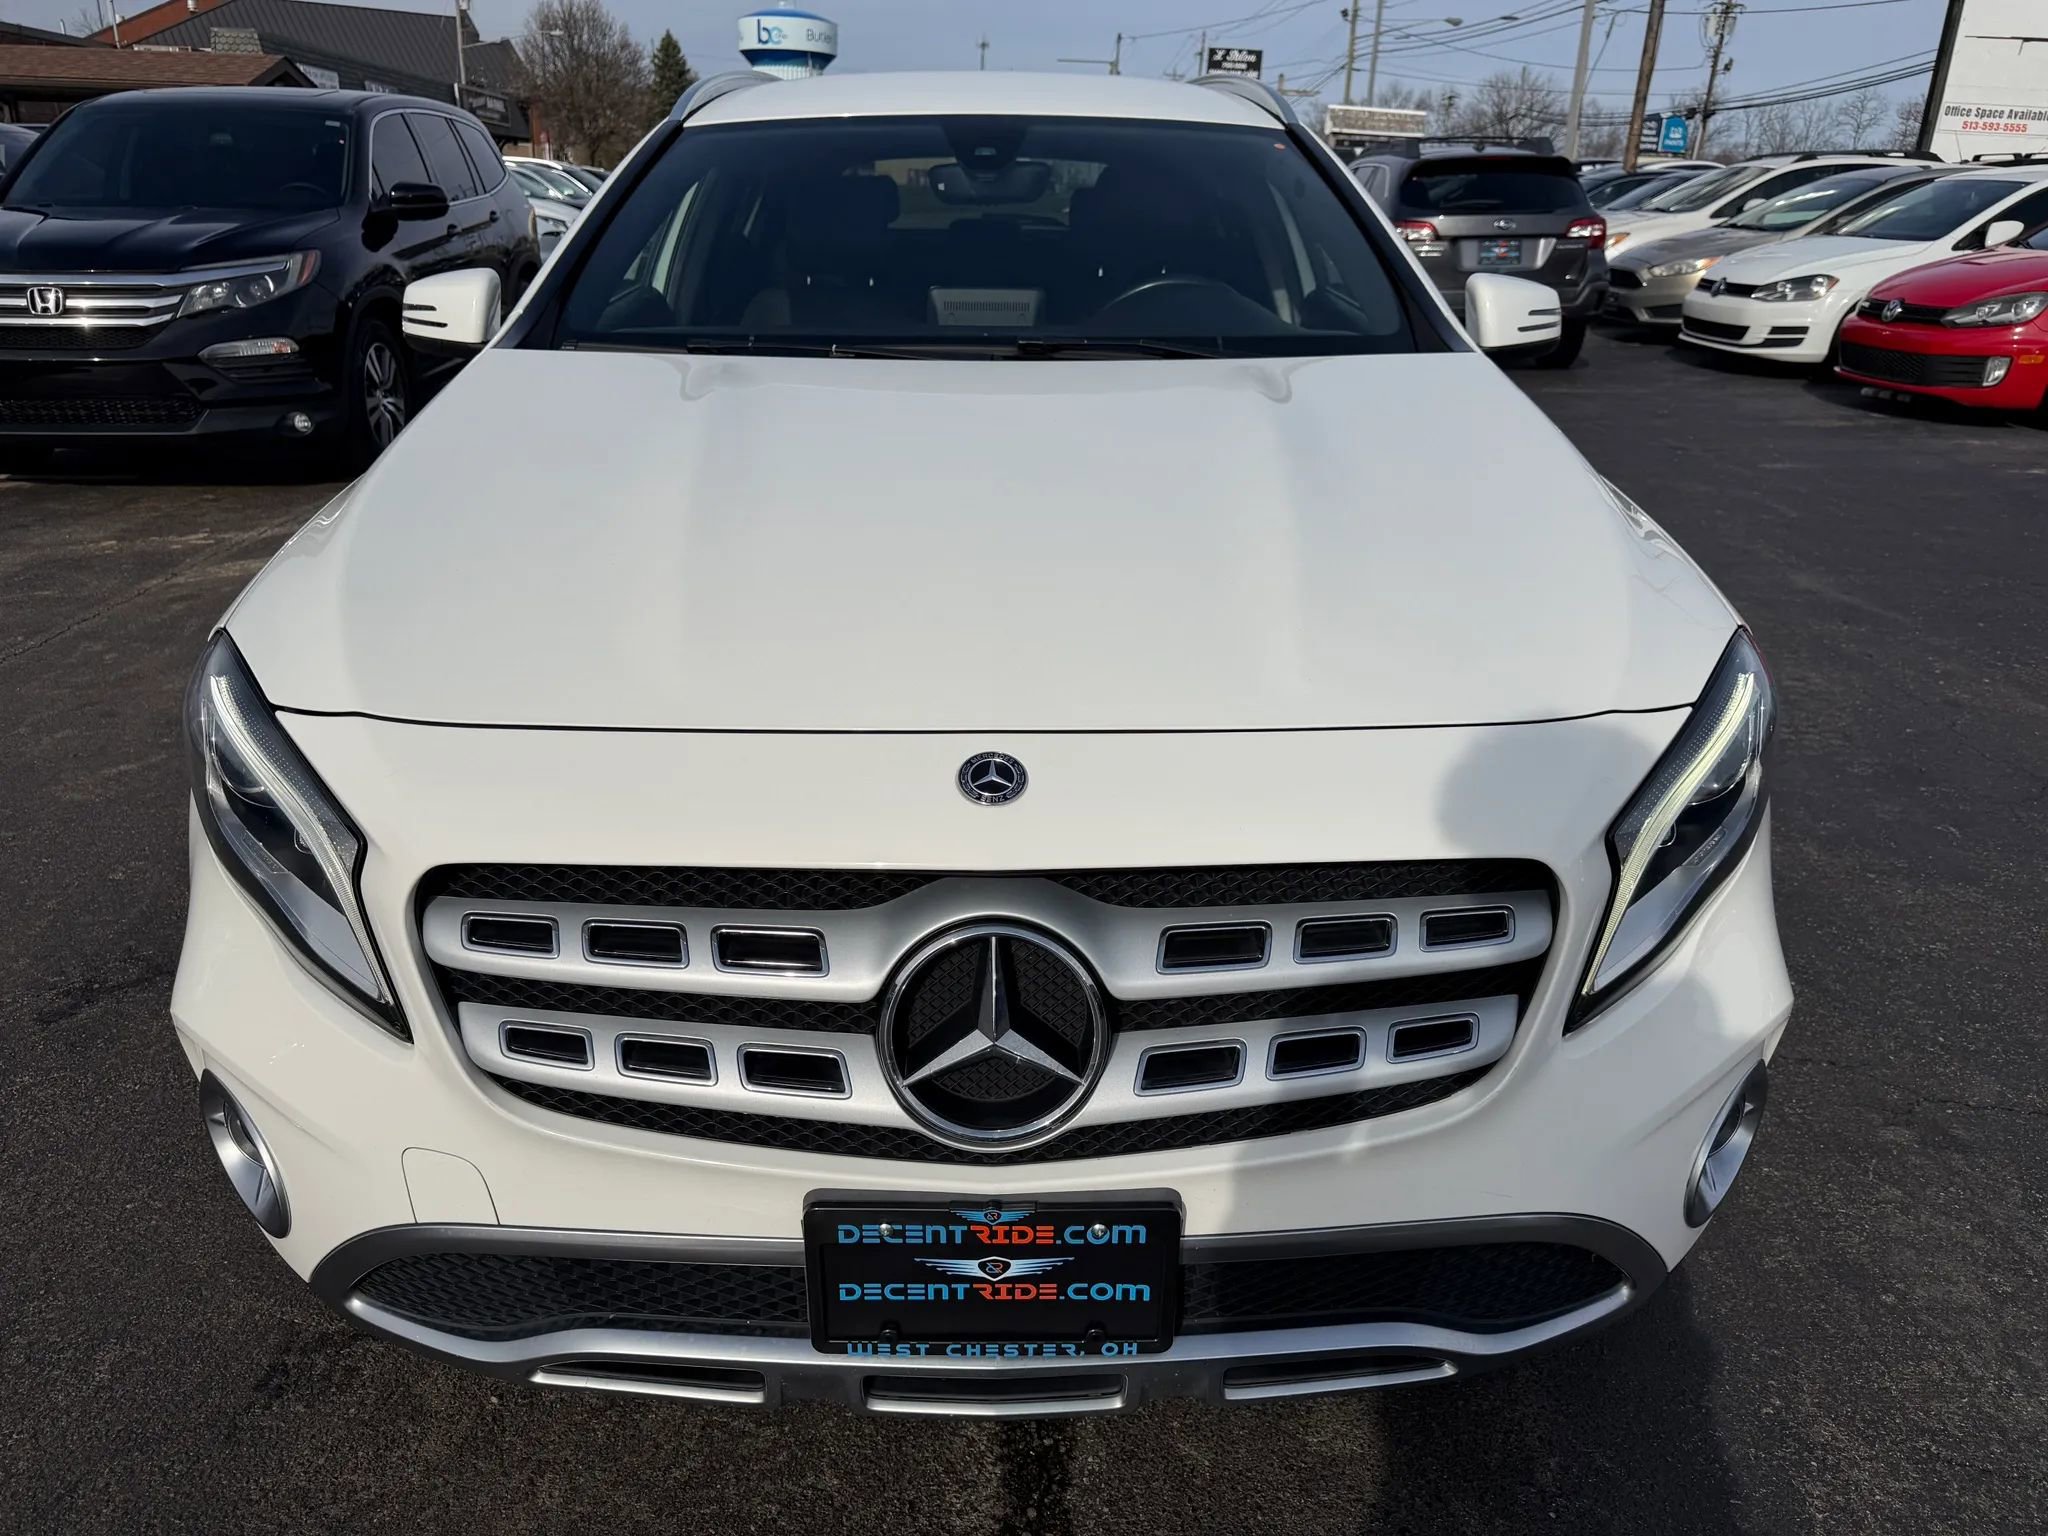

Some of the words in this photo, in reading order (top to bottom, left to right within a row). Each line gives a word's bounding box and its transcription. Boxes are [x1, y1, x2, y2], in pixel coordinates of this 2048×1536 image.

[1944, 105, 1972, 117] Office
[1974, 107, 2004, 119] Space
[2007, 109, 2048, 121] Availabl
[1961, 121, 2028, 132] 513-593-5555
[980, 795, 1005, 803] BENZ
[847, 1342, 929, 1358] WEST
[946, 1343, 1085, 1358] CHESTER,
[1101, 1342, 1138, 1357] OH
